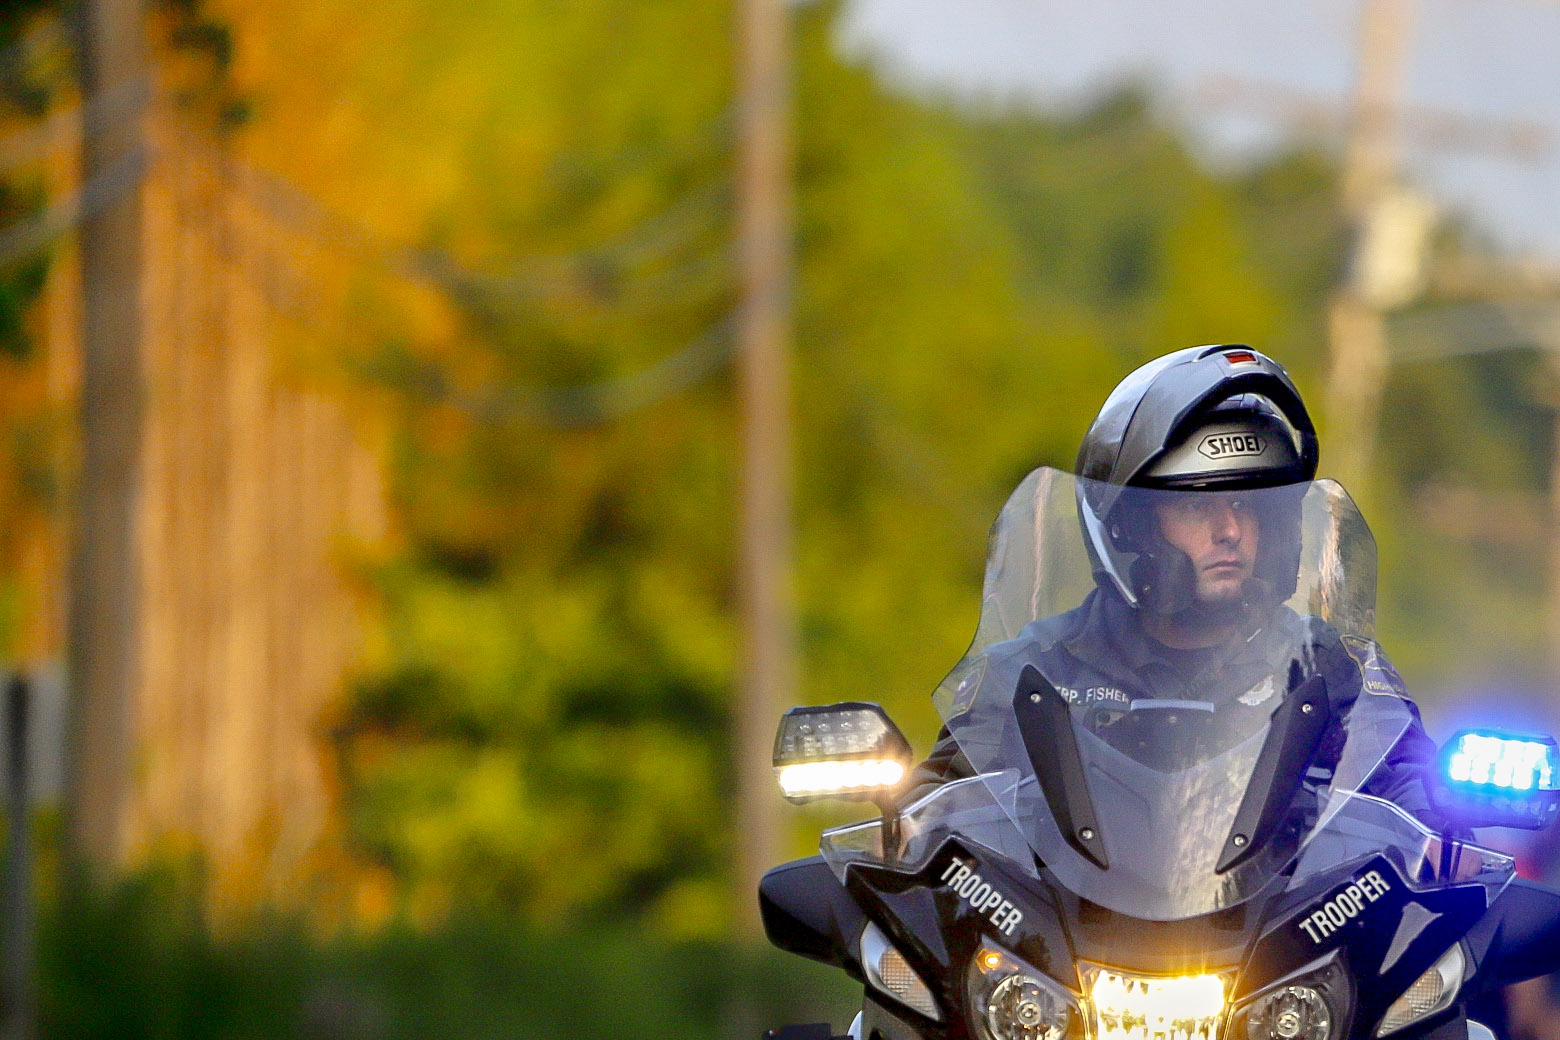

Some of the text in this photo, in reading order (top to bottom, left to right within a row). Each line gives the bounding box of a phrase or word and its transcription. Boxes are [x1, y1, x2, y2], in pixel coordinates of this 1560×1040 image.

[1207, 435, 1261, 455] SHOEI
[940, 856, 1023, 937] TROOPER
[1298, 870, 1391, 944] TROOPER
